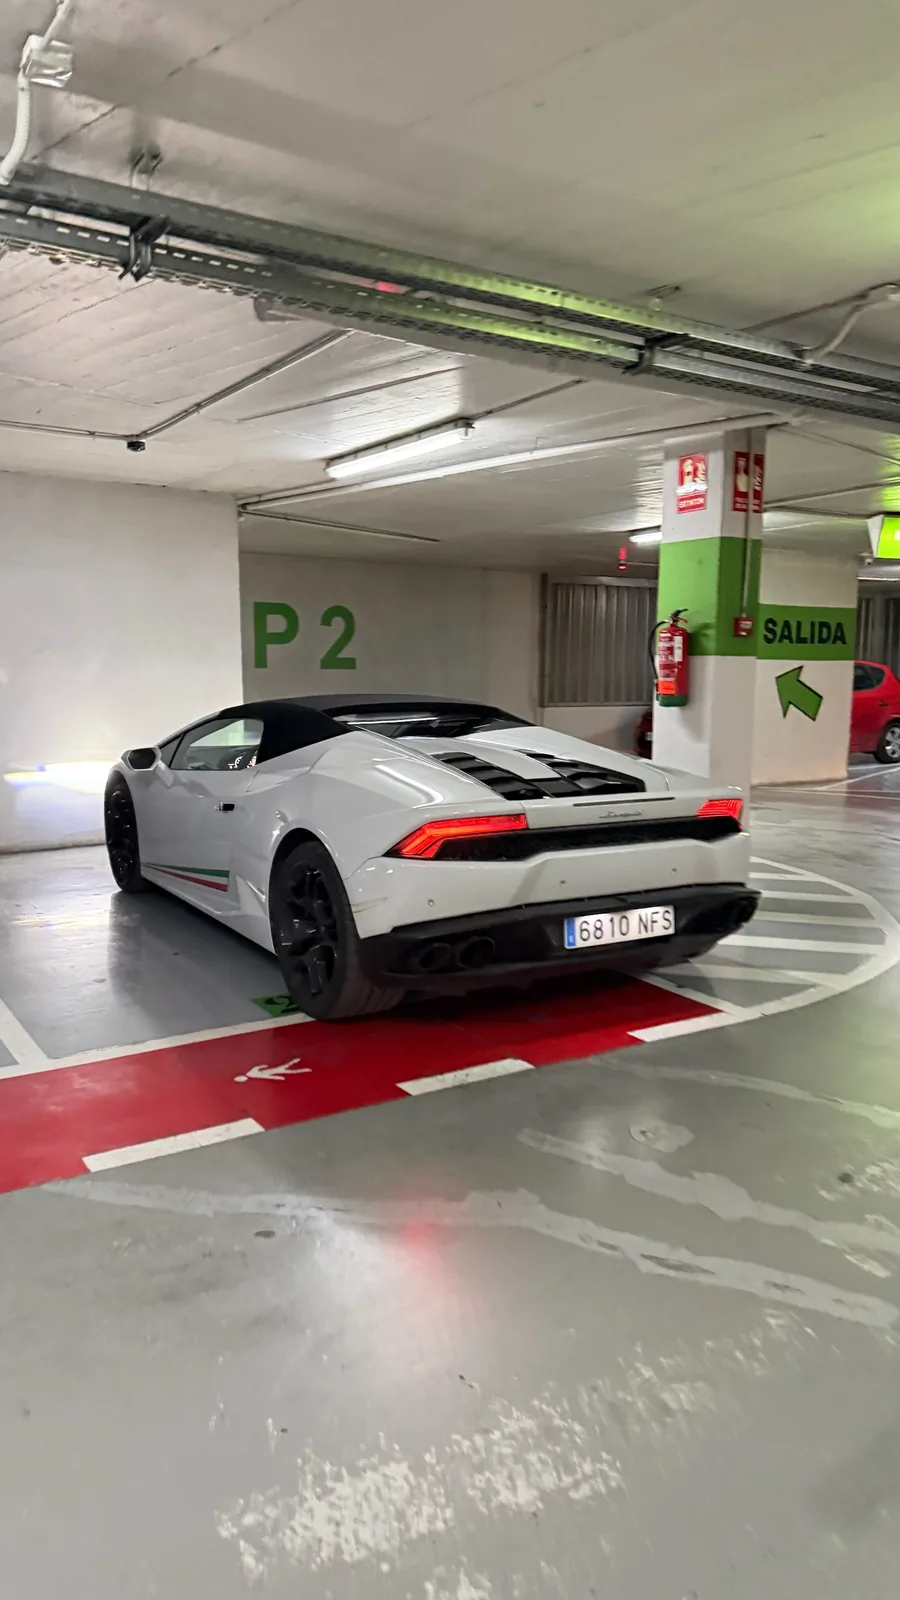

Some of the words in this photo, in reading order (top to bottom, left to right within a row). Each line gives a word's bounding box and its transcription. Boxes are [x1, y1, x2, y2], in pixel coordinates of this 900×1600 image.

[253, 601, 299, 669] P
[320, 604, 357, 670] 2
[763, 617, 847, 645] SALIDA
[579, 915, 630, 942] 6810
[638, 909, 672, 935] NFS
